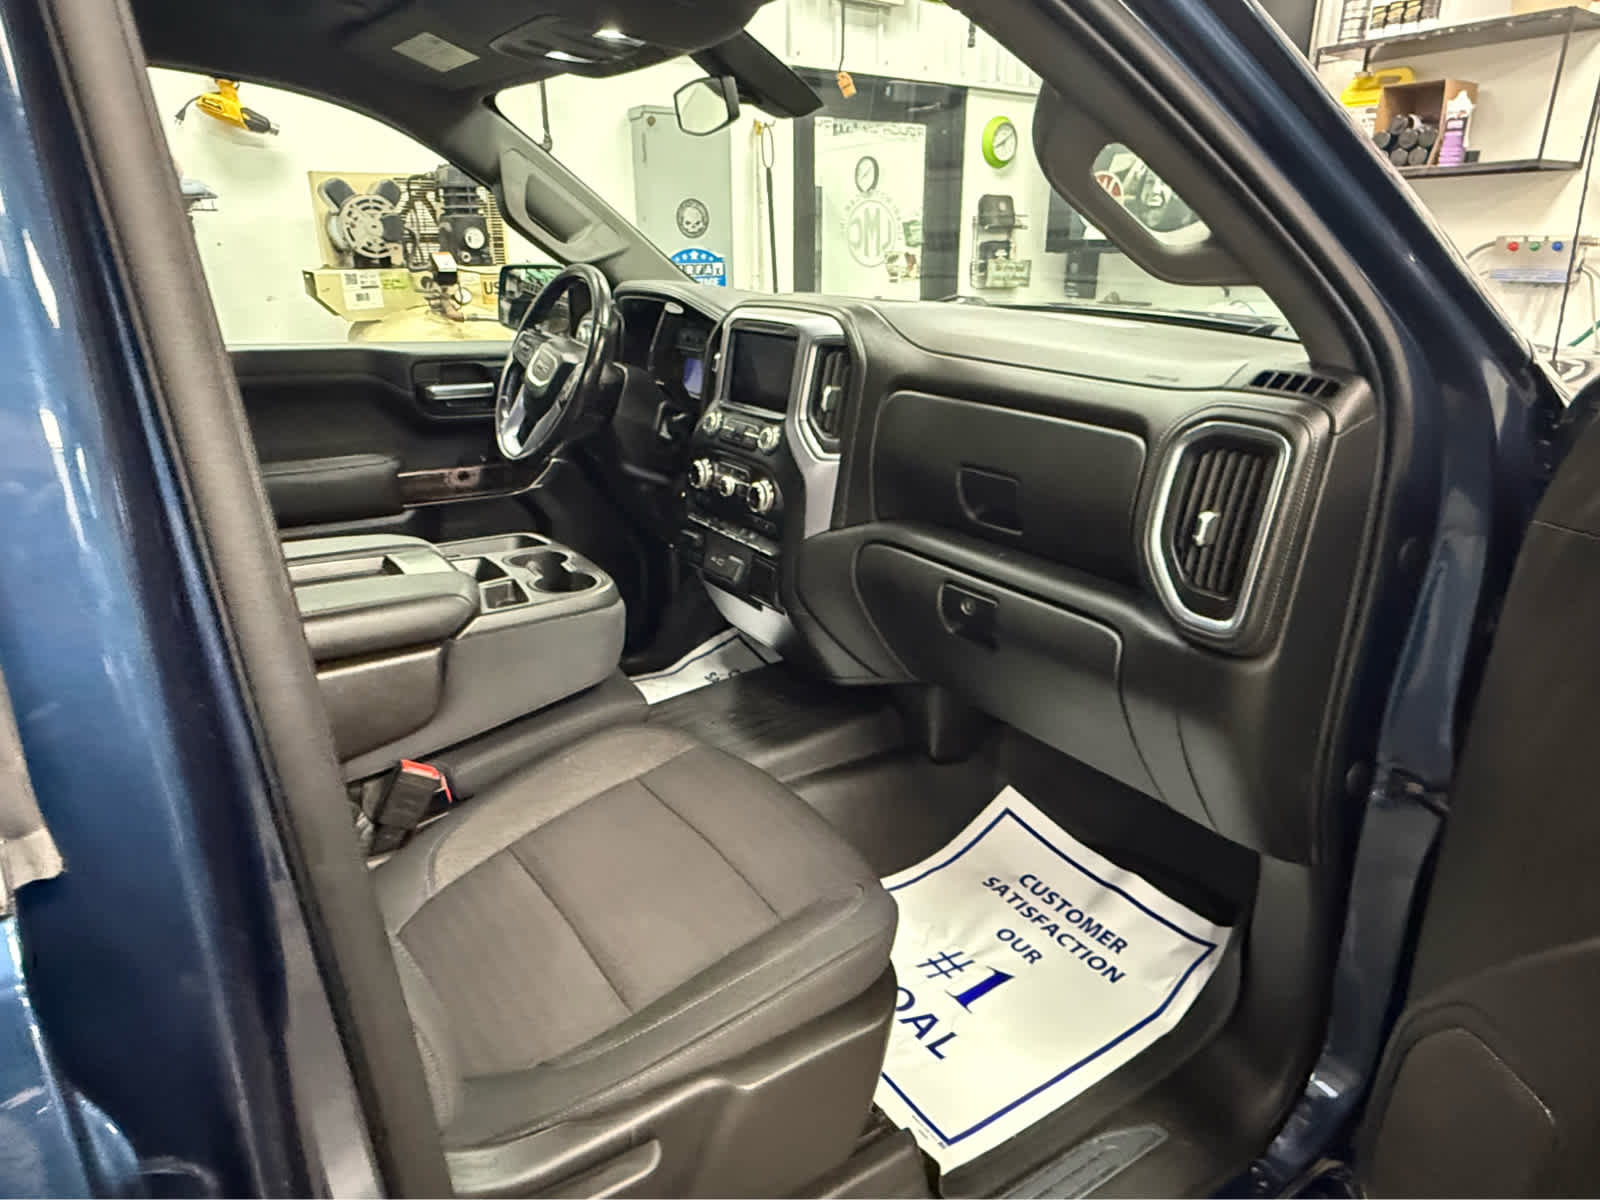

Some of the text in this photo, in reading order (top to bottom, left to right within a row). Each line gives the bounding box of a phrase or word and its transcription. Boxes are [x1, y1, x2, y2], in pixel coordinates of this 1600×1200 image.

[982, 876, 1127, 984] SATISFACTION
[996, 927, 1043, 965] OUR
[1018, 873, 1129, 955] CUSTOMER
[916, 951, 1016, 1014] #1
[896, 986, 957, 1060] OAL
